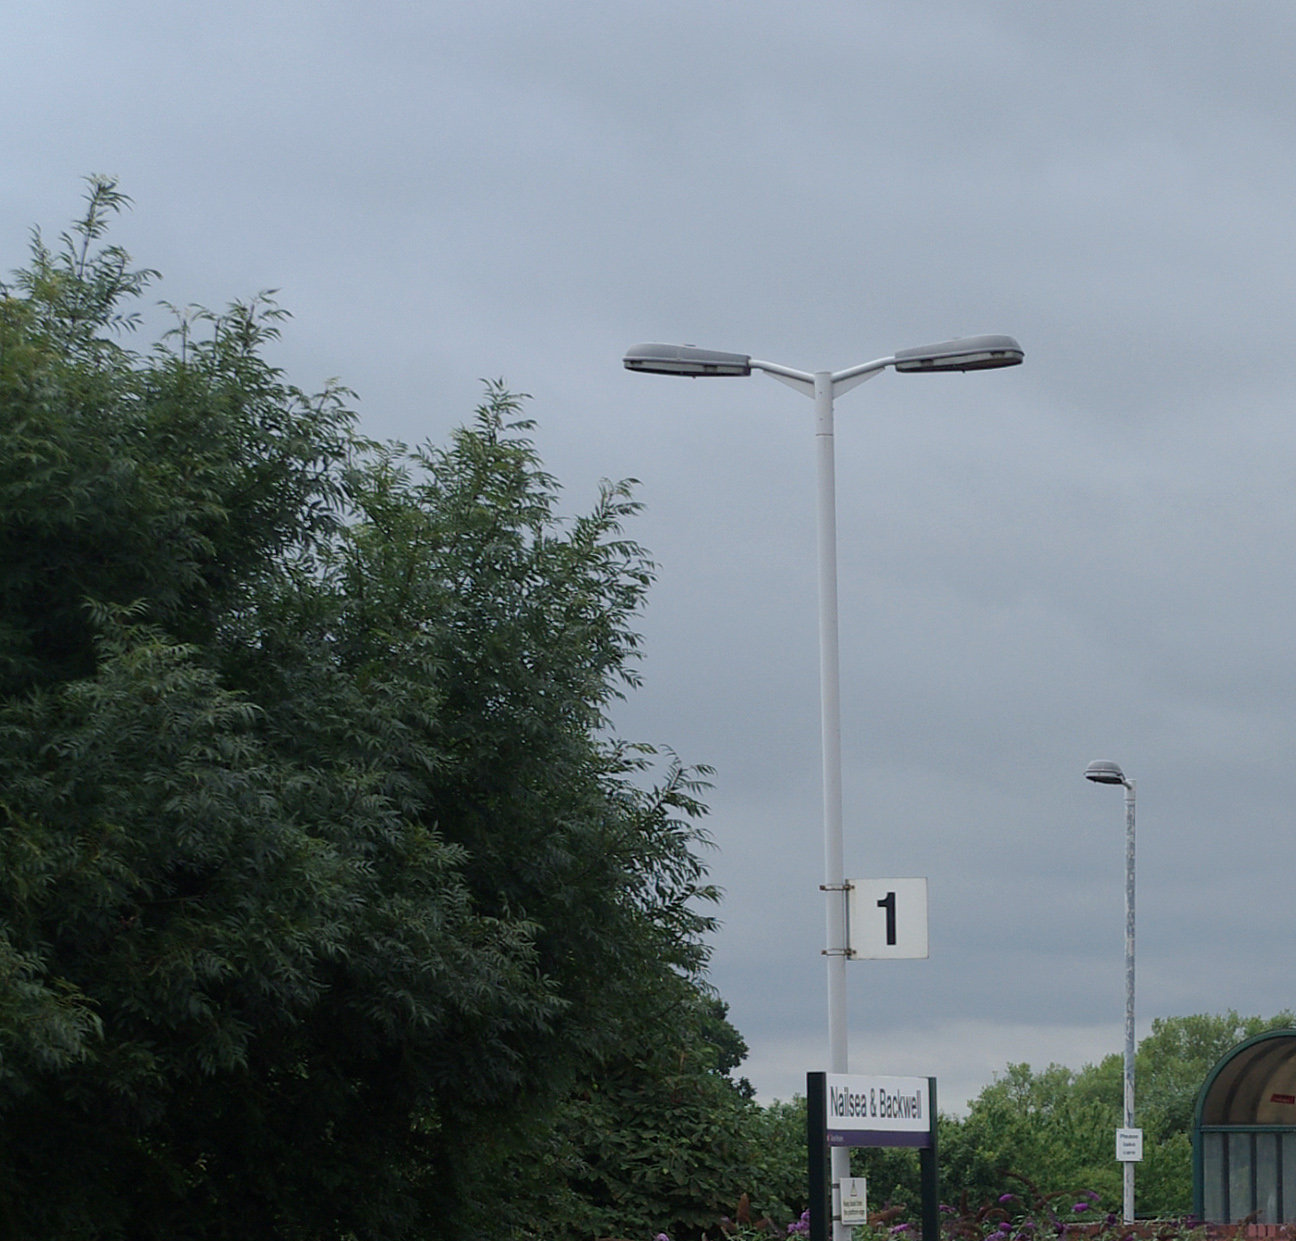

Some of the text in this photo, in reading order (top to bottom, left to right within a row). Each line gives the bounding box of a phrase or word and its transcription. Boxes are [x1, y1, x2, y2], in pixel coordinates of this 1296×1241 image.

[877, 892, 896, 945] 1
[830, 1086, 922, 1119] Nailsea & Backwell
